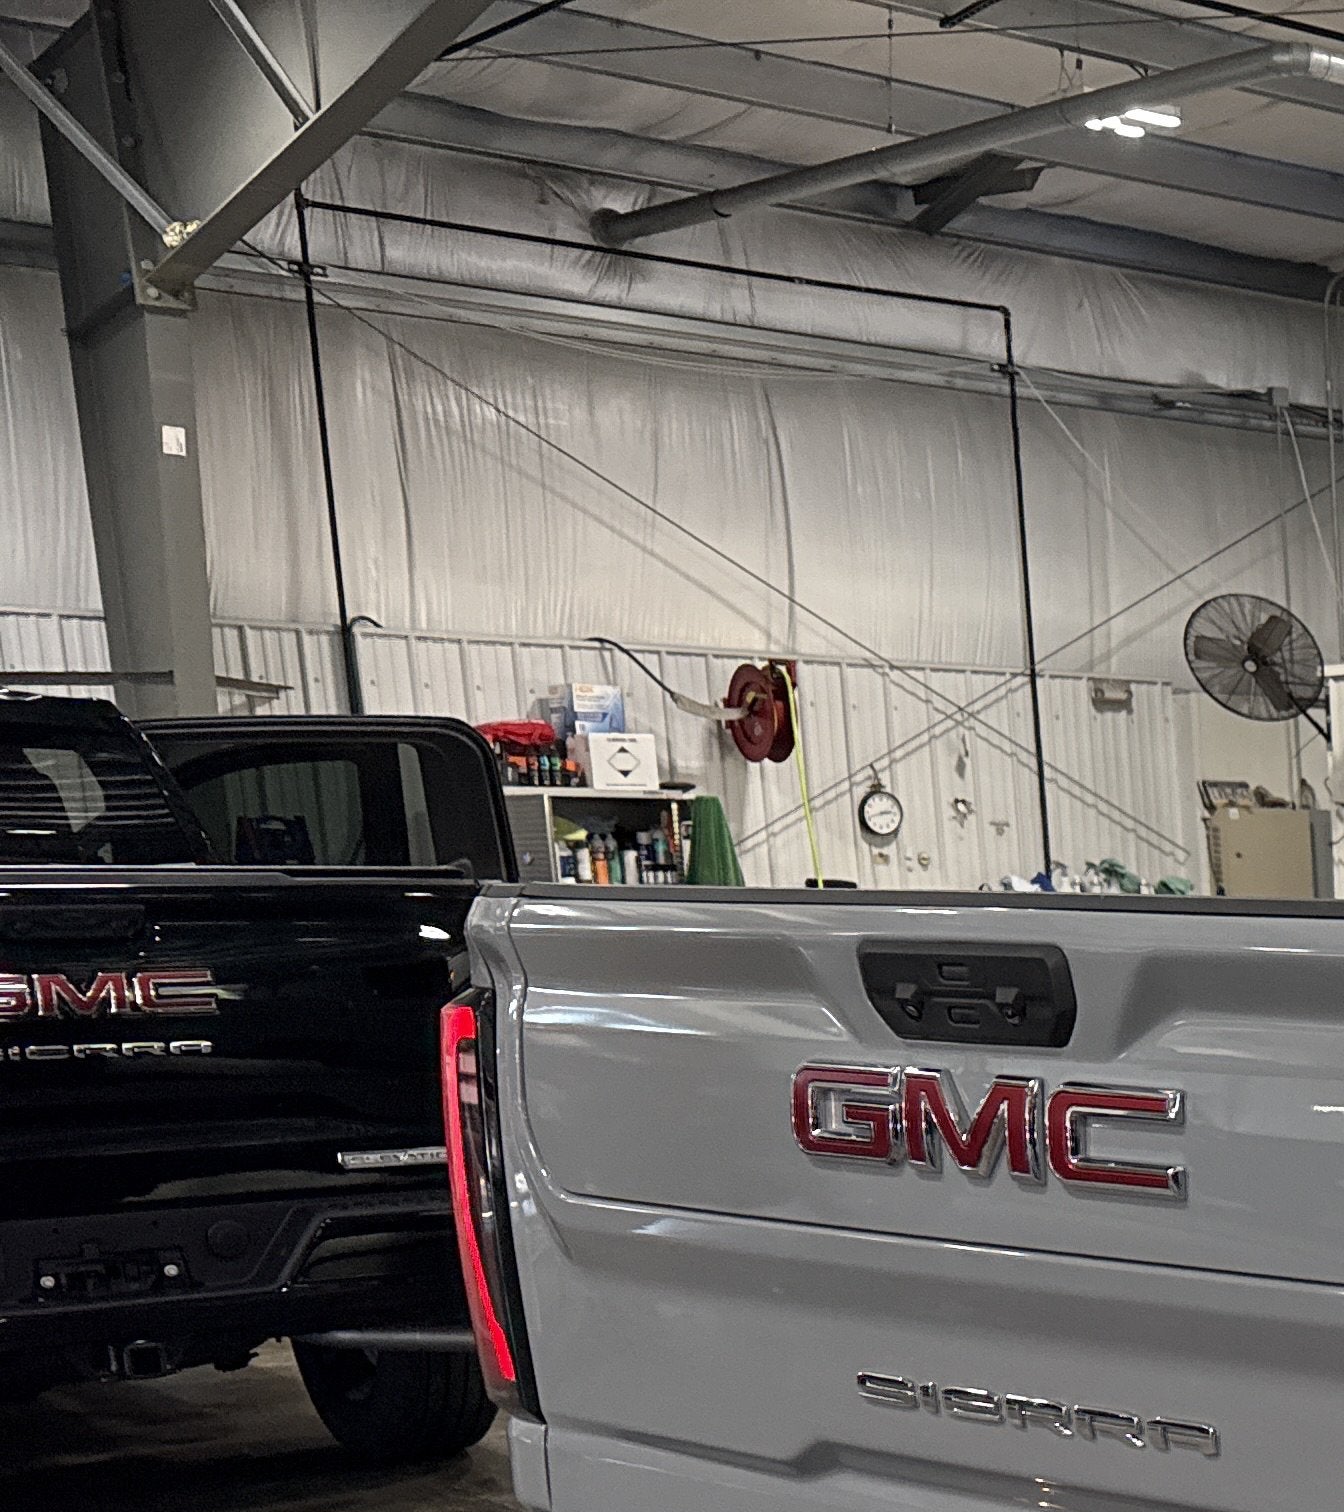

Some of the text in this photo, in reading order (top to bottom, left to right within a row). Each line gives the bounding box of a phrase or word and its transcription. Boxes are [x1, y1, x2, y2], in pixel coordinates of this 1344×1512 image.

[0, 1040, 213, 1061] IERRA
[791, 1060, 1186, 1200] GMC
[856, 1371, 1219, 1457] SIERRA
